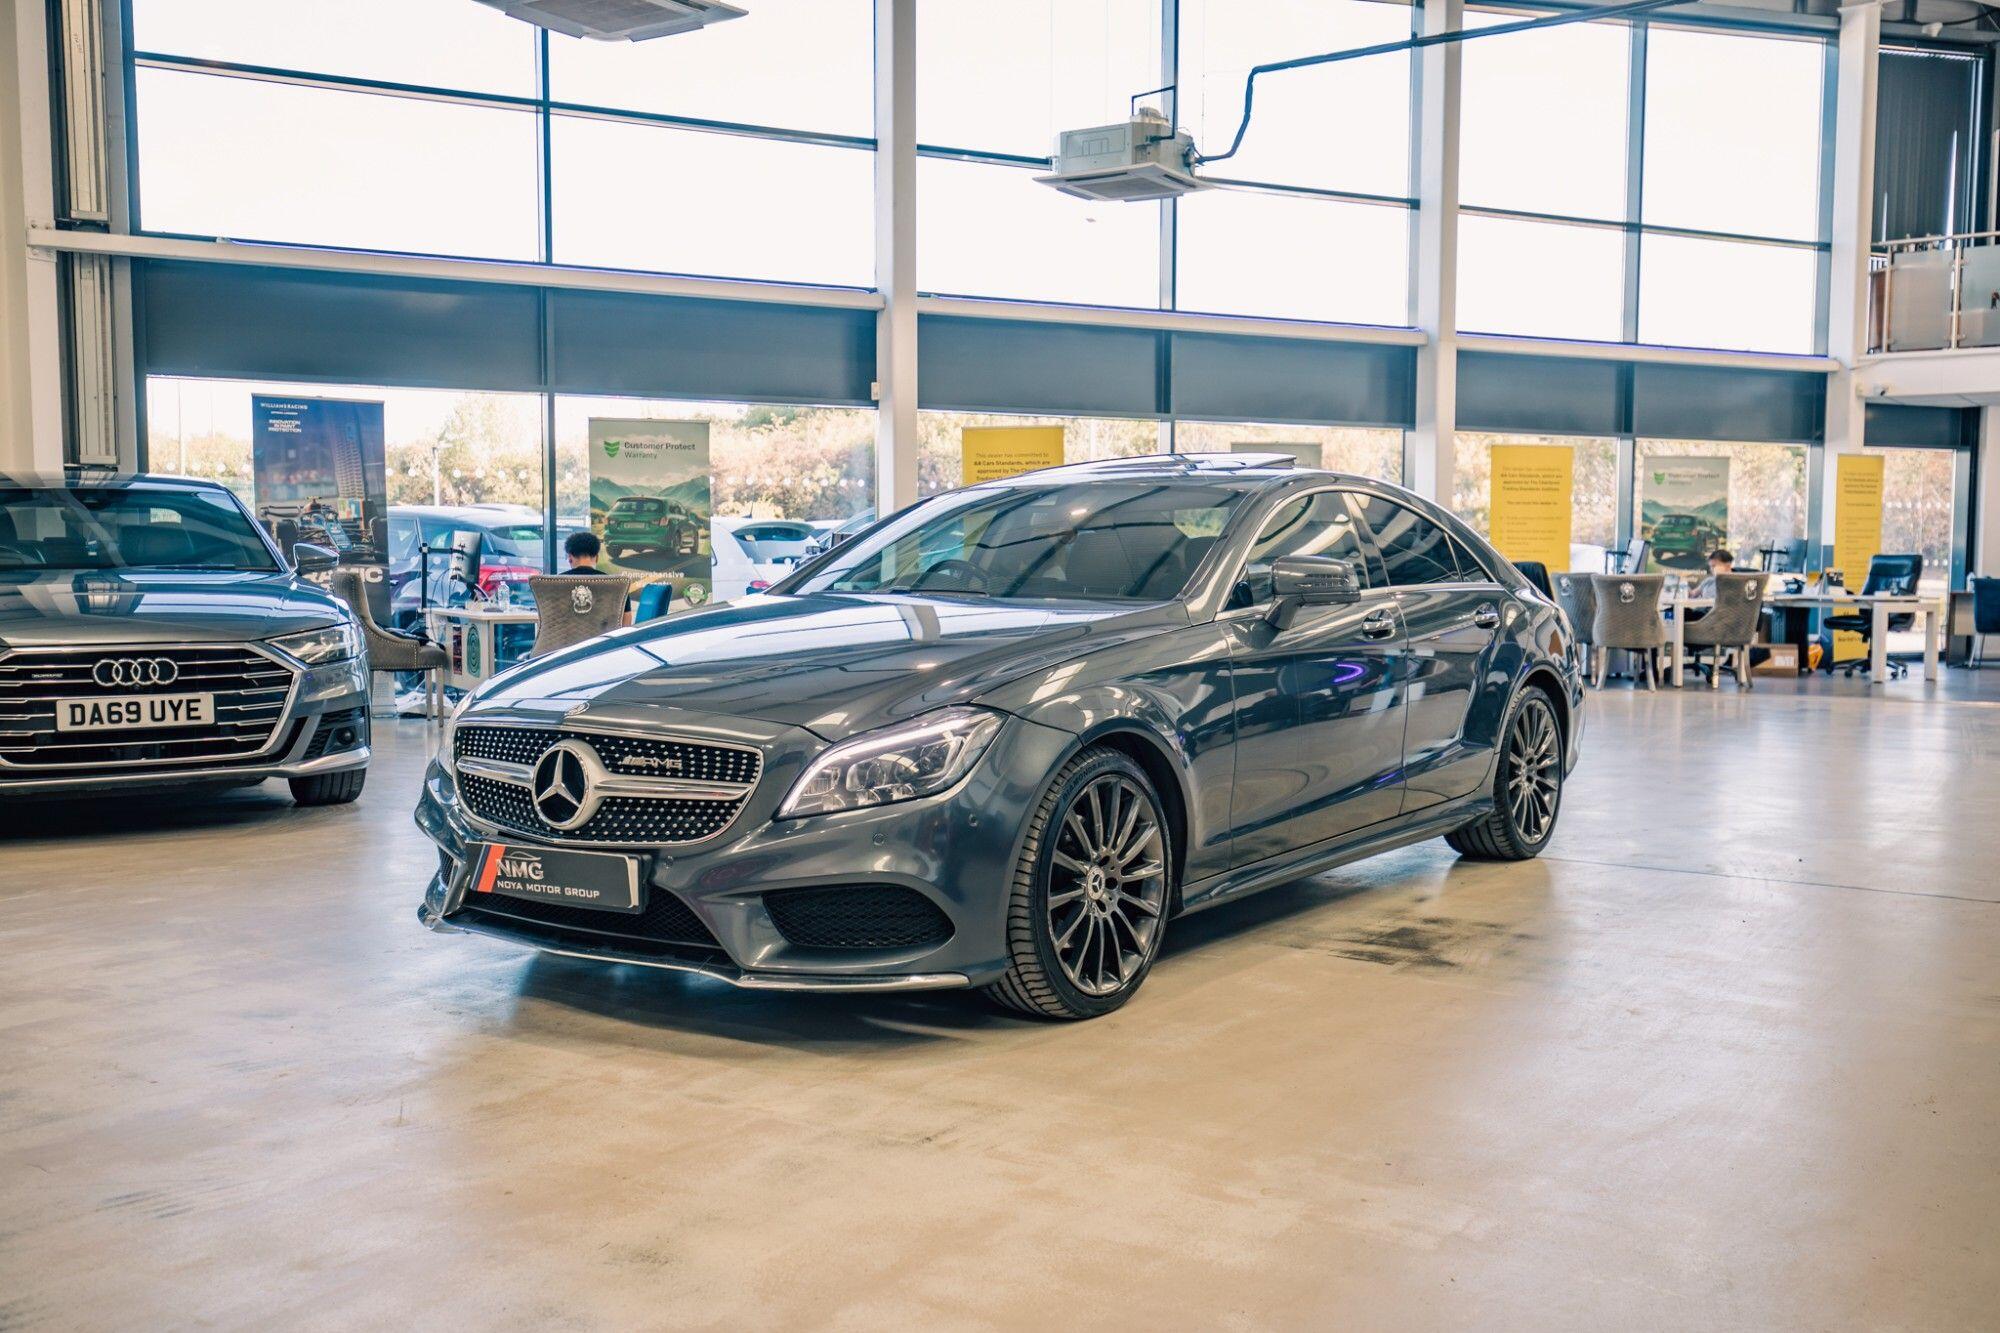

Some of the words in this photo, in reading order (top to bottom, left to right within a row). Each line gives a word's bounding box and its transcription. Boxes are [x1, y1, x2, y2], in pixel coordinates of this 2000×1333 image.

[624, 441, 664, 450] Customer
[665, 442, 696, 450] Protect
[624, 451, 657, 460] Warranty
[69, 701, 141, 726] DA69
[149, 699, 202, 722] UYE
[643, 757, 683, 770] AMG
[496, 859, 544, 880] NMG
[497, 880, 523, 891] NOYA
[526, 883, 561, 895] MOTOR
[564, 887, 600, 898] GROUP
